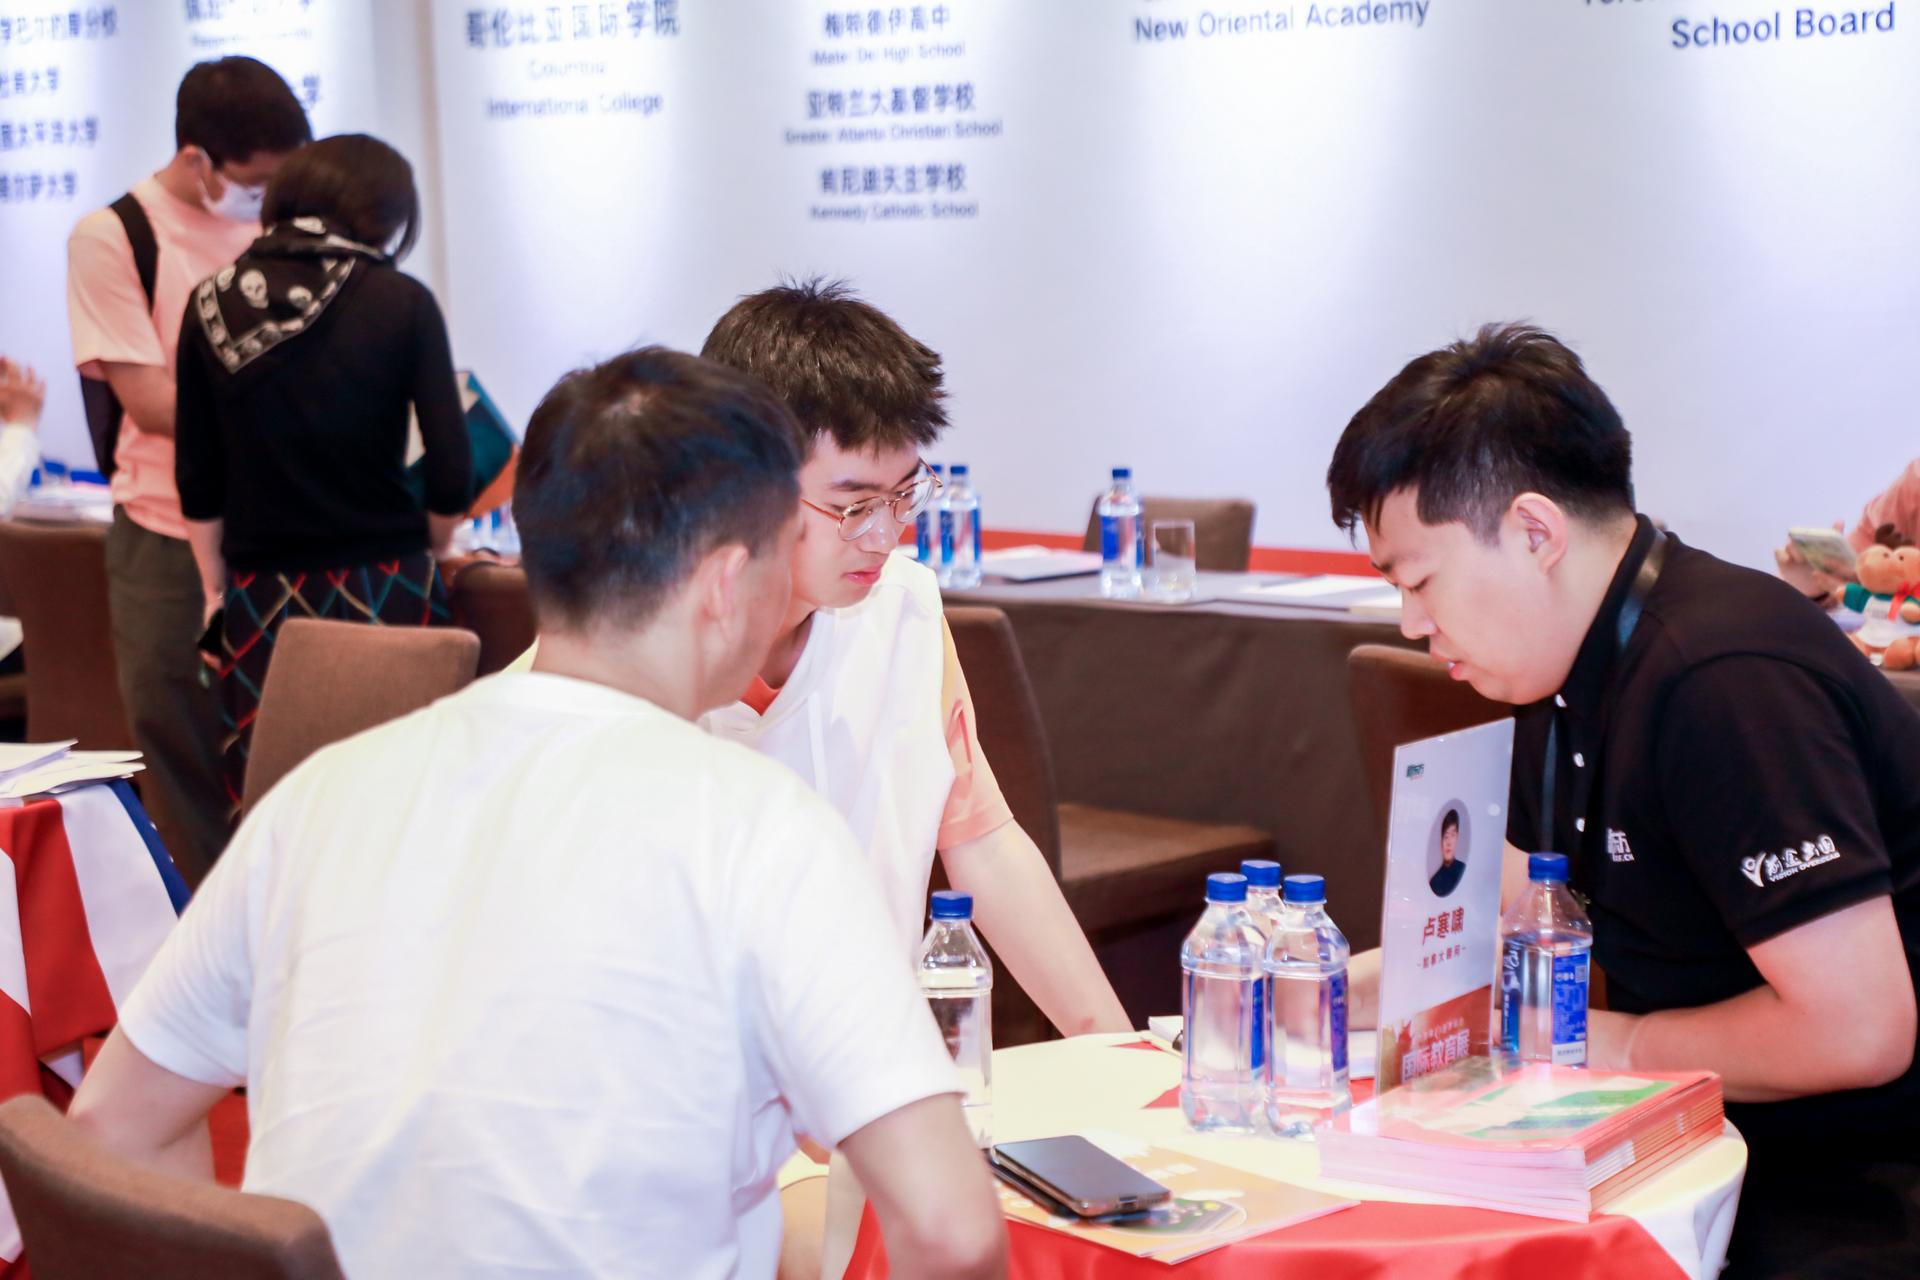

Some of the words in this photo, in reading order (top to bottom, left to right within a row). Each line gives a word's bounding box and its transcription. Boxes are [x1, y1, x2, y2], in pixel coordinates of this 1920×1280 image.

[1134, 17, 1187, 41] New
[1200, 8, 1294, 37] Oriental
[1306, 0, 1430, 27] Academy
[1671, 13, 1780, 48] School
[1795, 2, 1895, 38] Board
[920, 42, 966, 59] School
[807, 82, 975, 118] 亚特兰大基督学校
[891, 123, 950, 141] Christian
[956, 119, 1003, 138] School
[821, 163, 966, 194] 肯尼迪天主学校
[811, 204, 867, 222] Kennedy
[873, 202, 926, 219] Catholic
[932, 199, 979, 217] School
